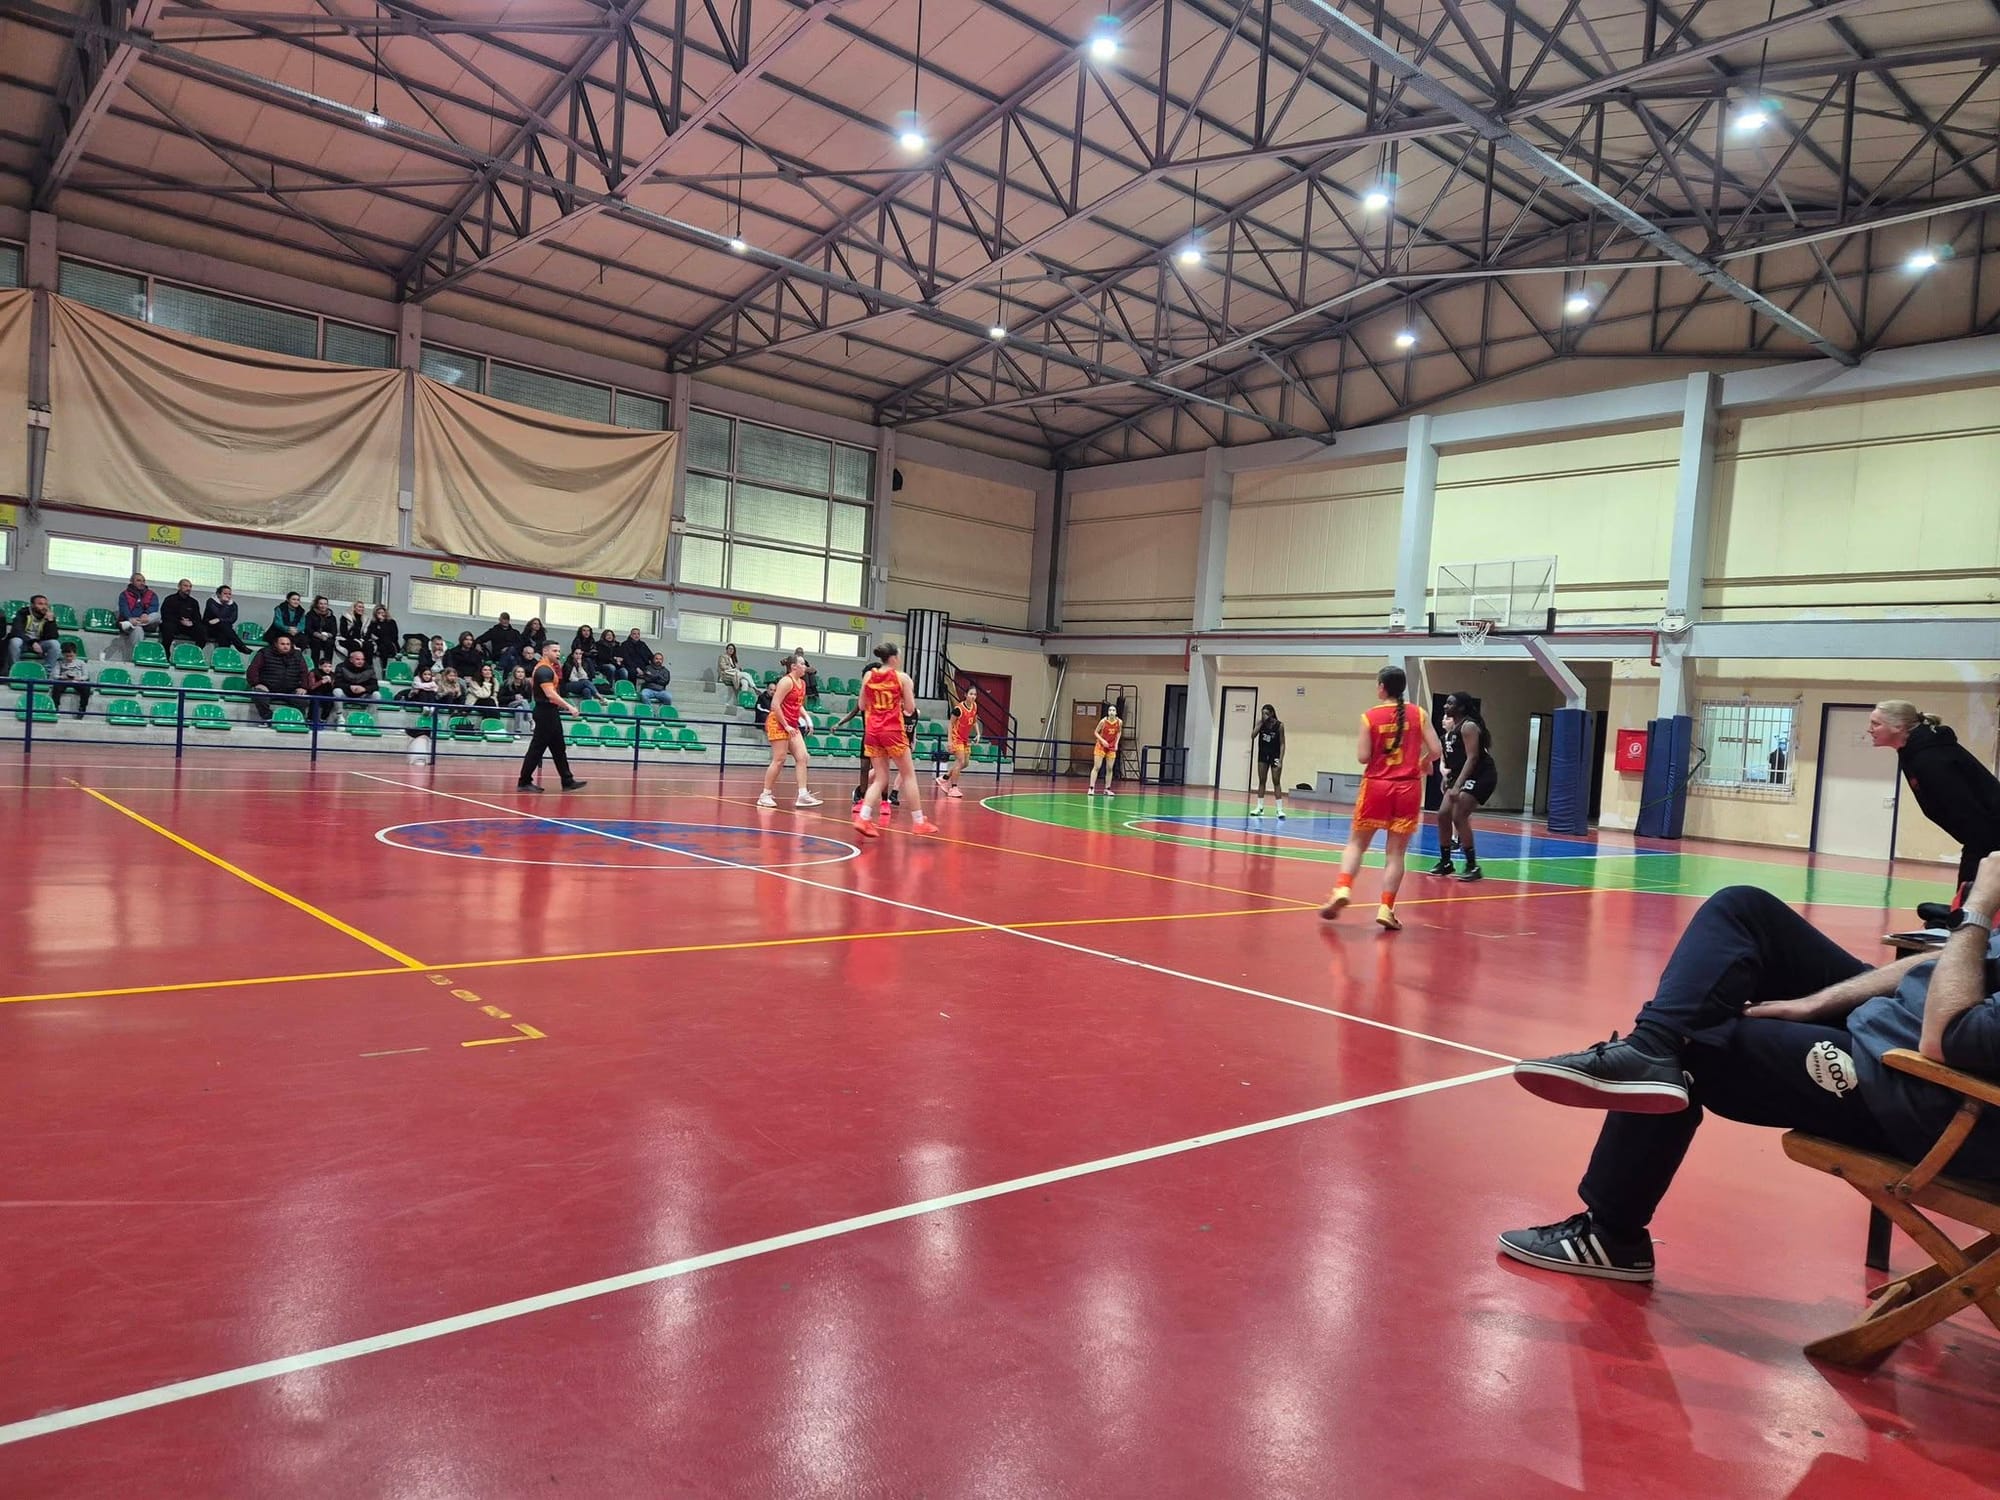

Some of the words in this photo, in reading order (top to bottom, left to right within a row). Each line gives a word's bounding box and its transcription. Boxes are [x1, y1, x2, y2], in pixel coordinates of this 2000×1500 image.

[1328, 778, 1334, 793] 1
[1821, 1043, 1838, 1060] SO
[1828, 1062, 1852, 1096] COOL
